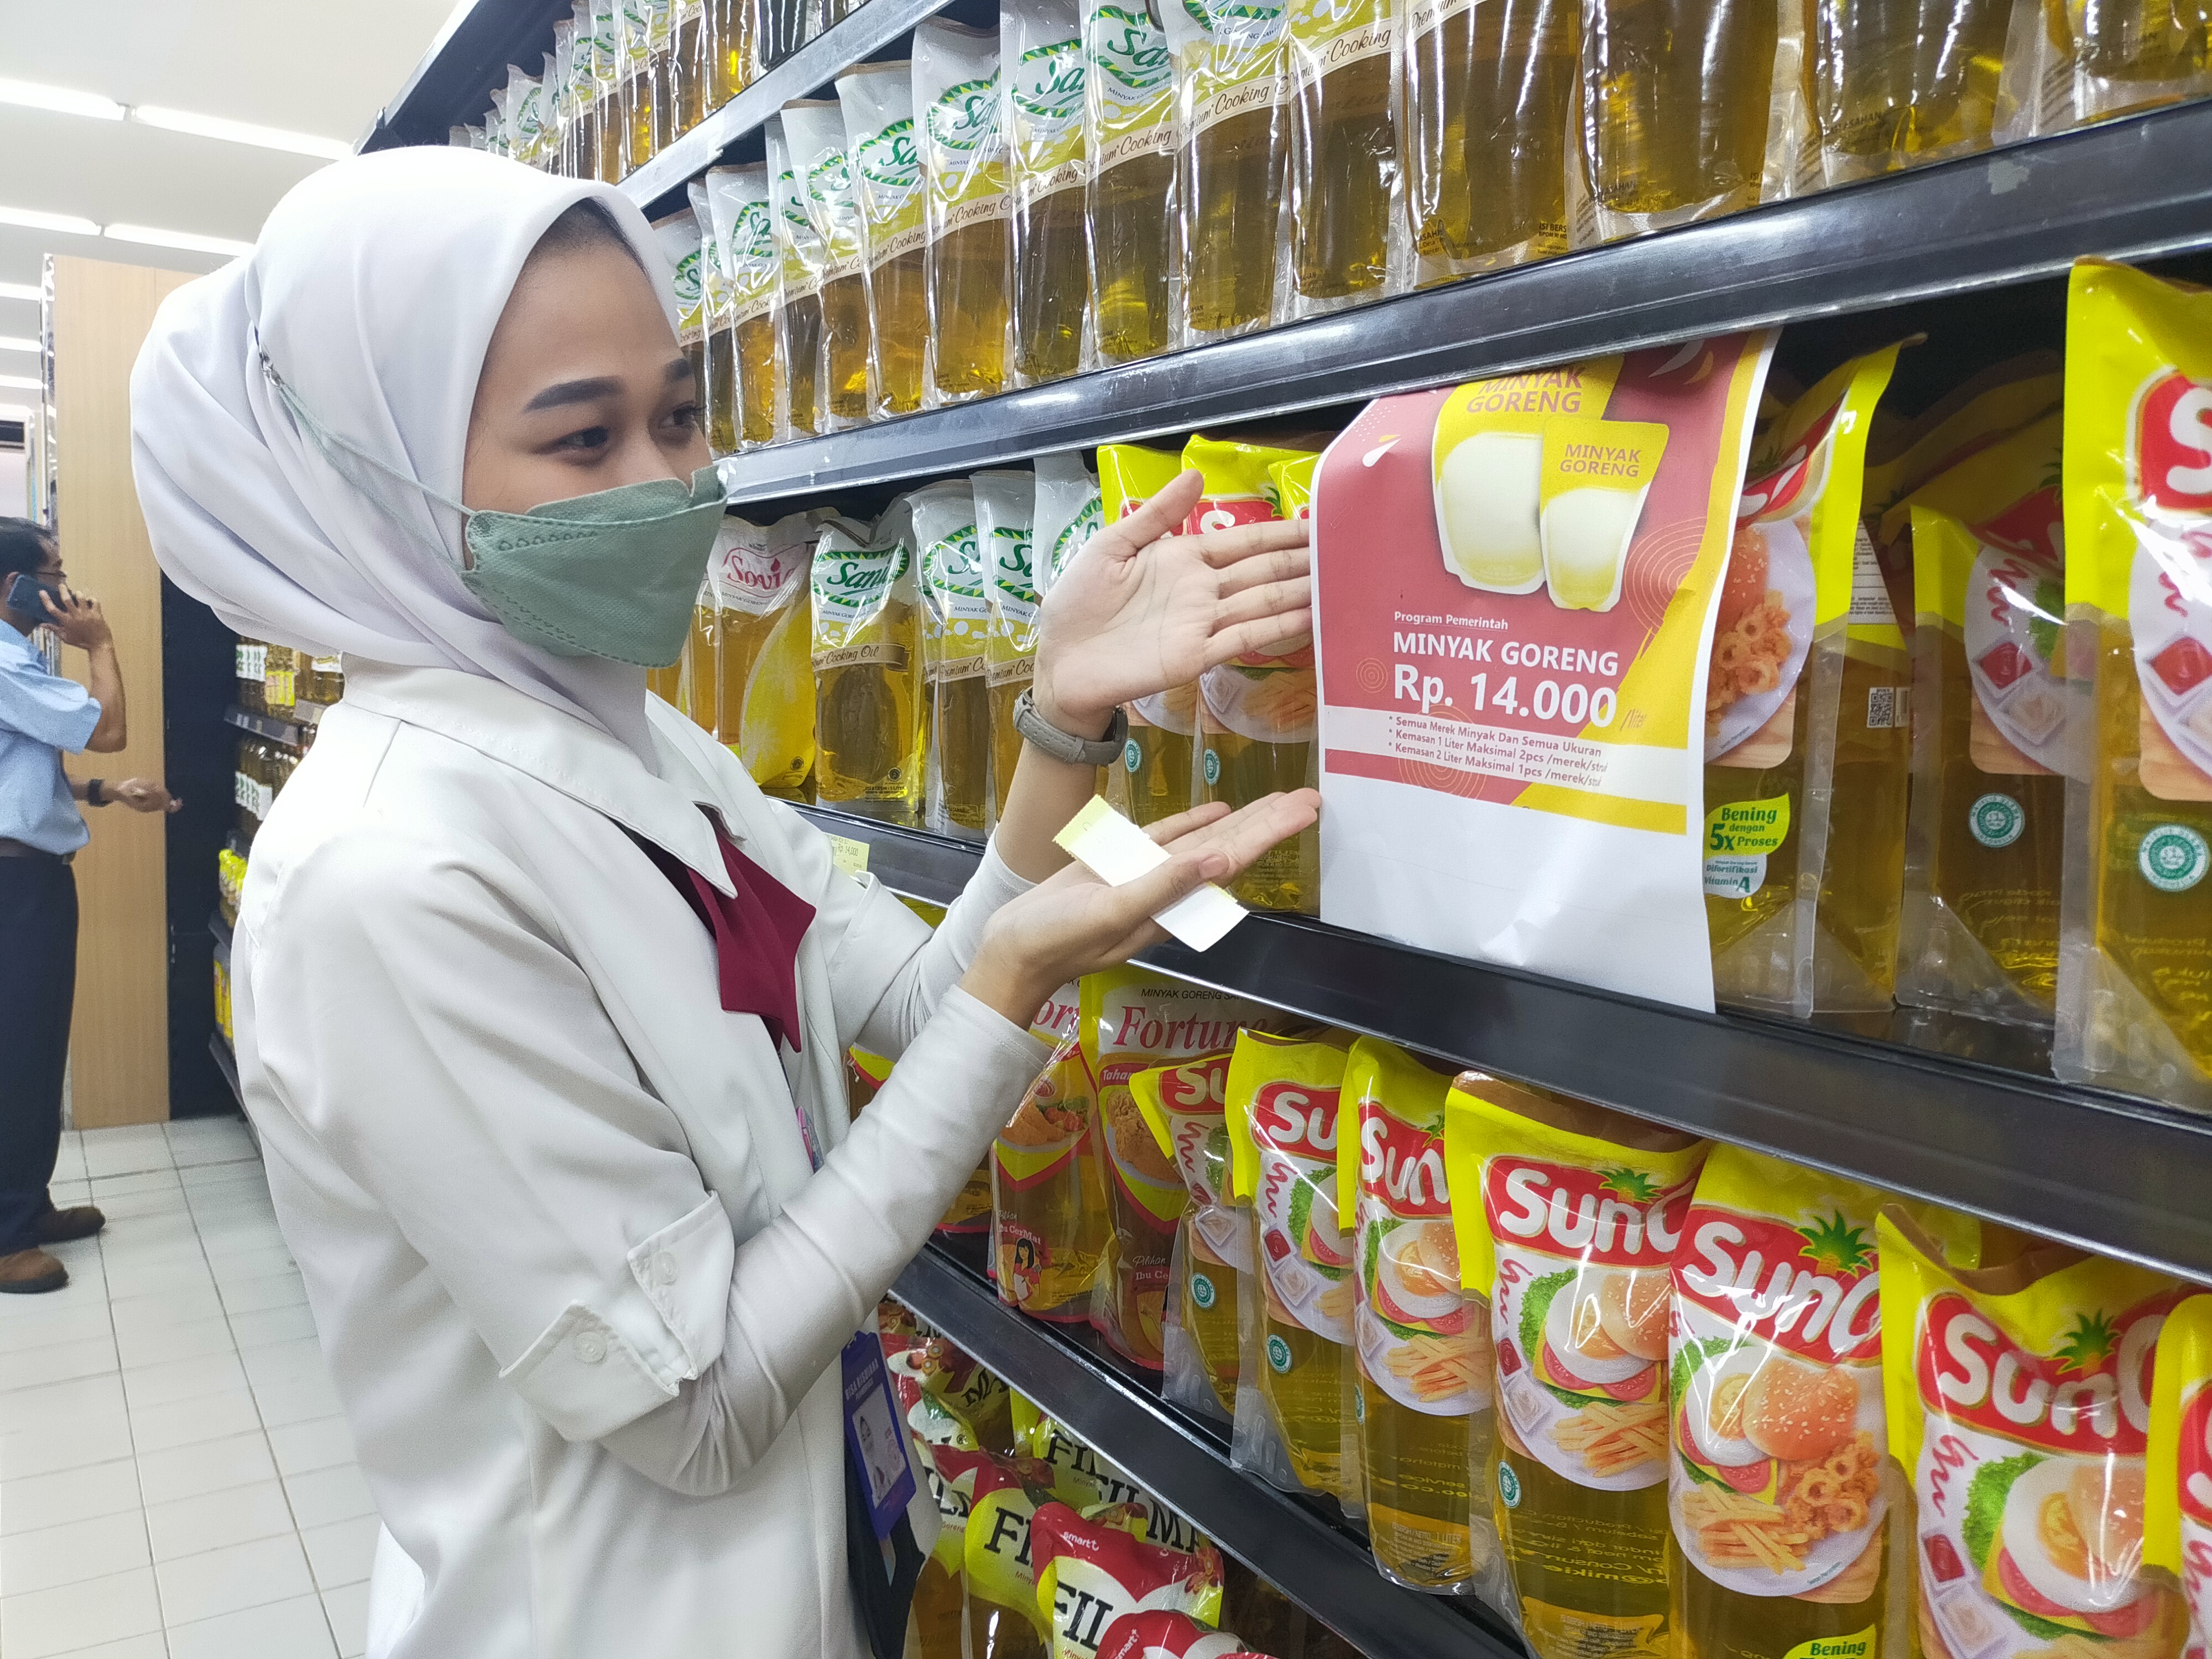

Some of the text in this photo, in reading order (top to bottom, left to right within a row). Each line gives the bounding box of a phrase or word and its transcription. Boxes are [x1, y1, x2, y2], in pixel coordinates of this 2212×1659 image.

[1331, 28, 1391, 62] Cooking
[1214, 86, 1270, 115] Cooking
[1120, 129, 1172, 156] Cooking
[955, 202, 997, 224] Cooking
[890, 231, 926, 253] Cooking
[1478, 365, 1584, 395] MINYAK
[1466, 390, 1582, 414] GORENG
[1565, 444, 1641, 463] MINYAK
[1560, 459, 1640, 478] GORENG
[1394, 611, 1509, 630] Program Pemerintah
[826, 650, 858, 664] Cooking
[860, 645, 880, 658] Oil
[1394, 632, 1619, 676] MINYAK GORENG
[1394, 664, 1618, 728] Rp. 14.000
[1396, 716, 1601, 758] Semua Merek Minyak Dan Semua Ukuran
[1396, 729, 1436, 744] Kemasan
[1438, 736, 1442, 746] 1
[1444, 737, 1464, 750] Liter
[1467, 741, 1516, 758] Maksimal
[1519, 749, 1544, 764] 2pcs
[1395, 742, 1434, 758] Kemasan
[1436, 749, 1442, 760] 2
[1443, 750, 1463, 764] Liter
[1465, 755, 1514, 773] Maksimal
[1519, 764, 1542, 778] 1pcs
[1721, 806, 1778, 825] Bening
[1729, 823, 1765, 834] dengan
[1737, 836, 1778, 847] Proses
[1735, 876, 1750, 893] A
[1141, 988, 1180, 999] MINYAK
[1181, 990, 1222, 1000] GORENG
[1133, 1255, 1167, 1267] Pilihan
[1135, 1271, 1152, 1281] Ibu
[1809, 1641, 1867, 1656] Bening
